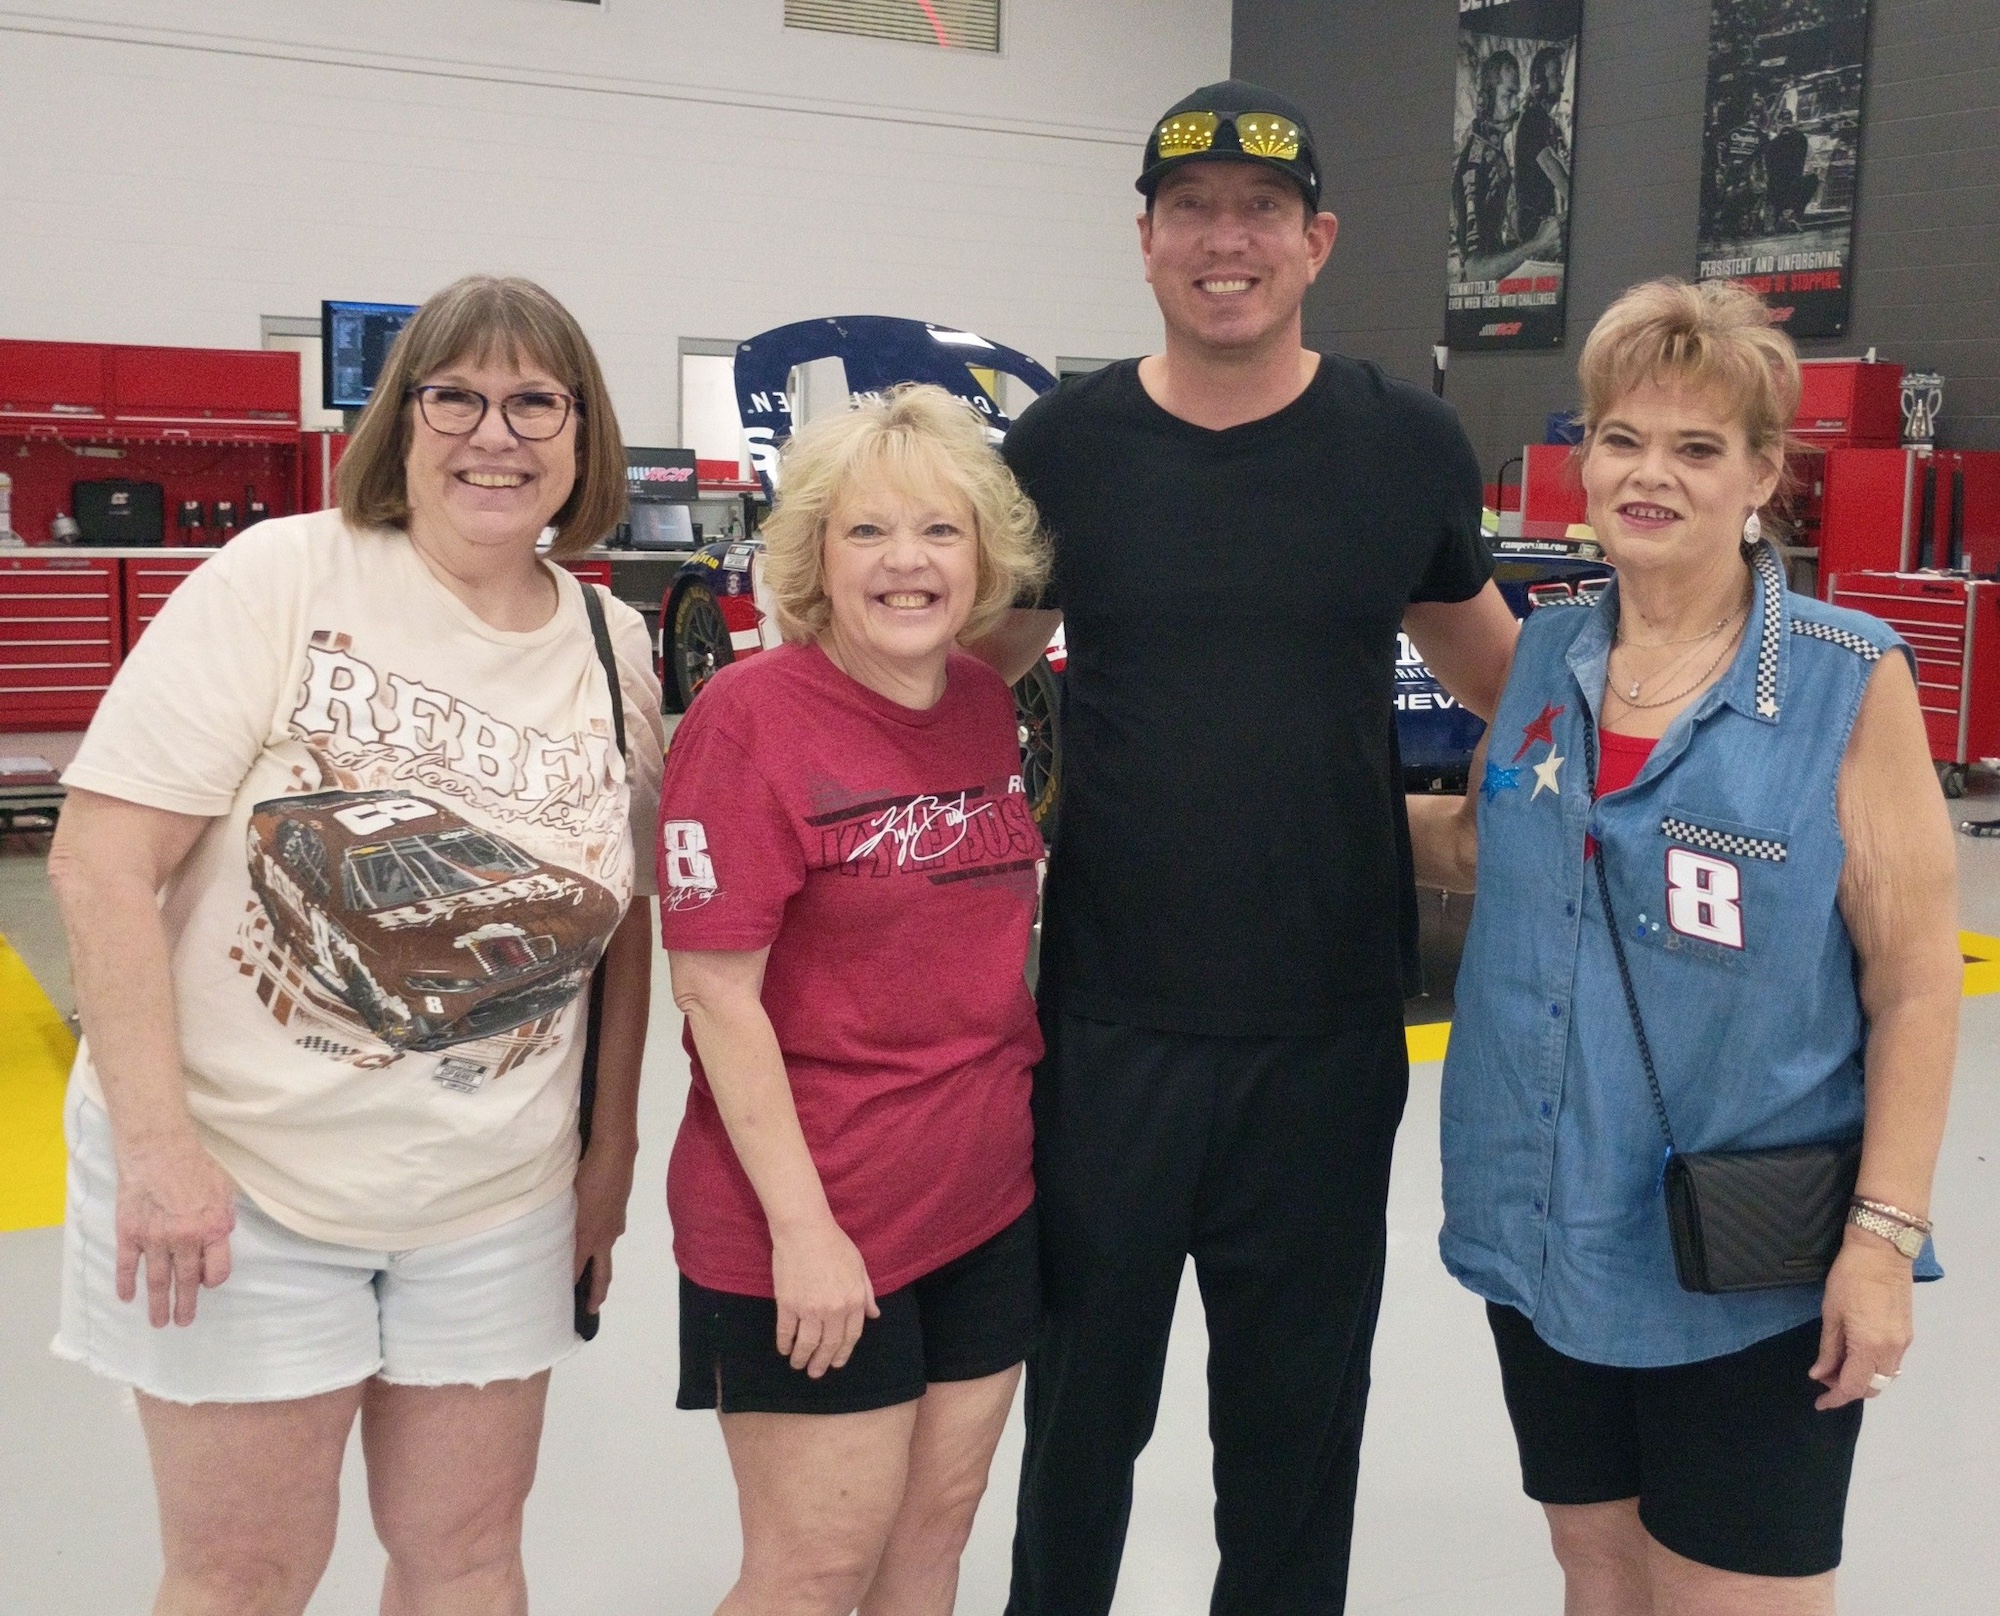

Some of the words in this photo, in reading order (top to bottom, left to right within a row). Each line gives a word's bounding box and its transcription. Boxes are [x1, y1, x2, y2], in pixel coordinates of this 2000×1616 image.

[1700, 258, 1752, 278] PERSISTENT
[1755, 256, 1774, 273] AND
[1777, 250, 1842, 271] UNFORGIVING.
[664, 819, 718, 890] 8
[1664, 845, 1746, 952] 8
[424, 995, 445, 1014] 8
